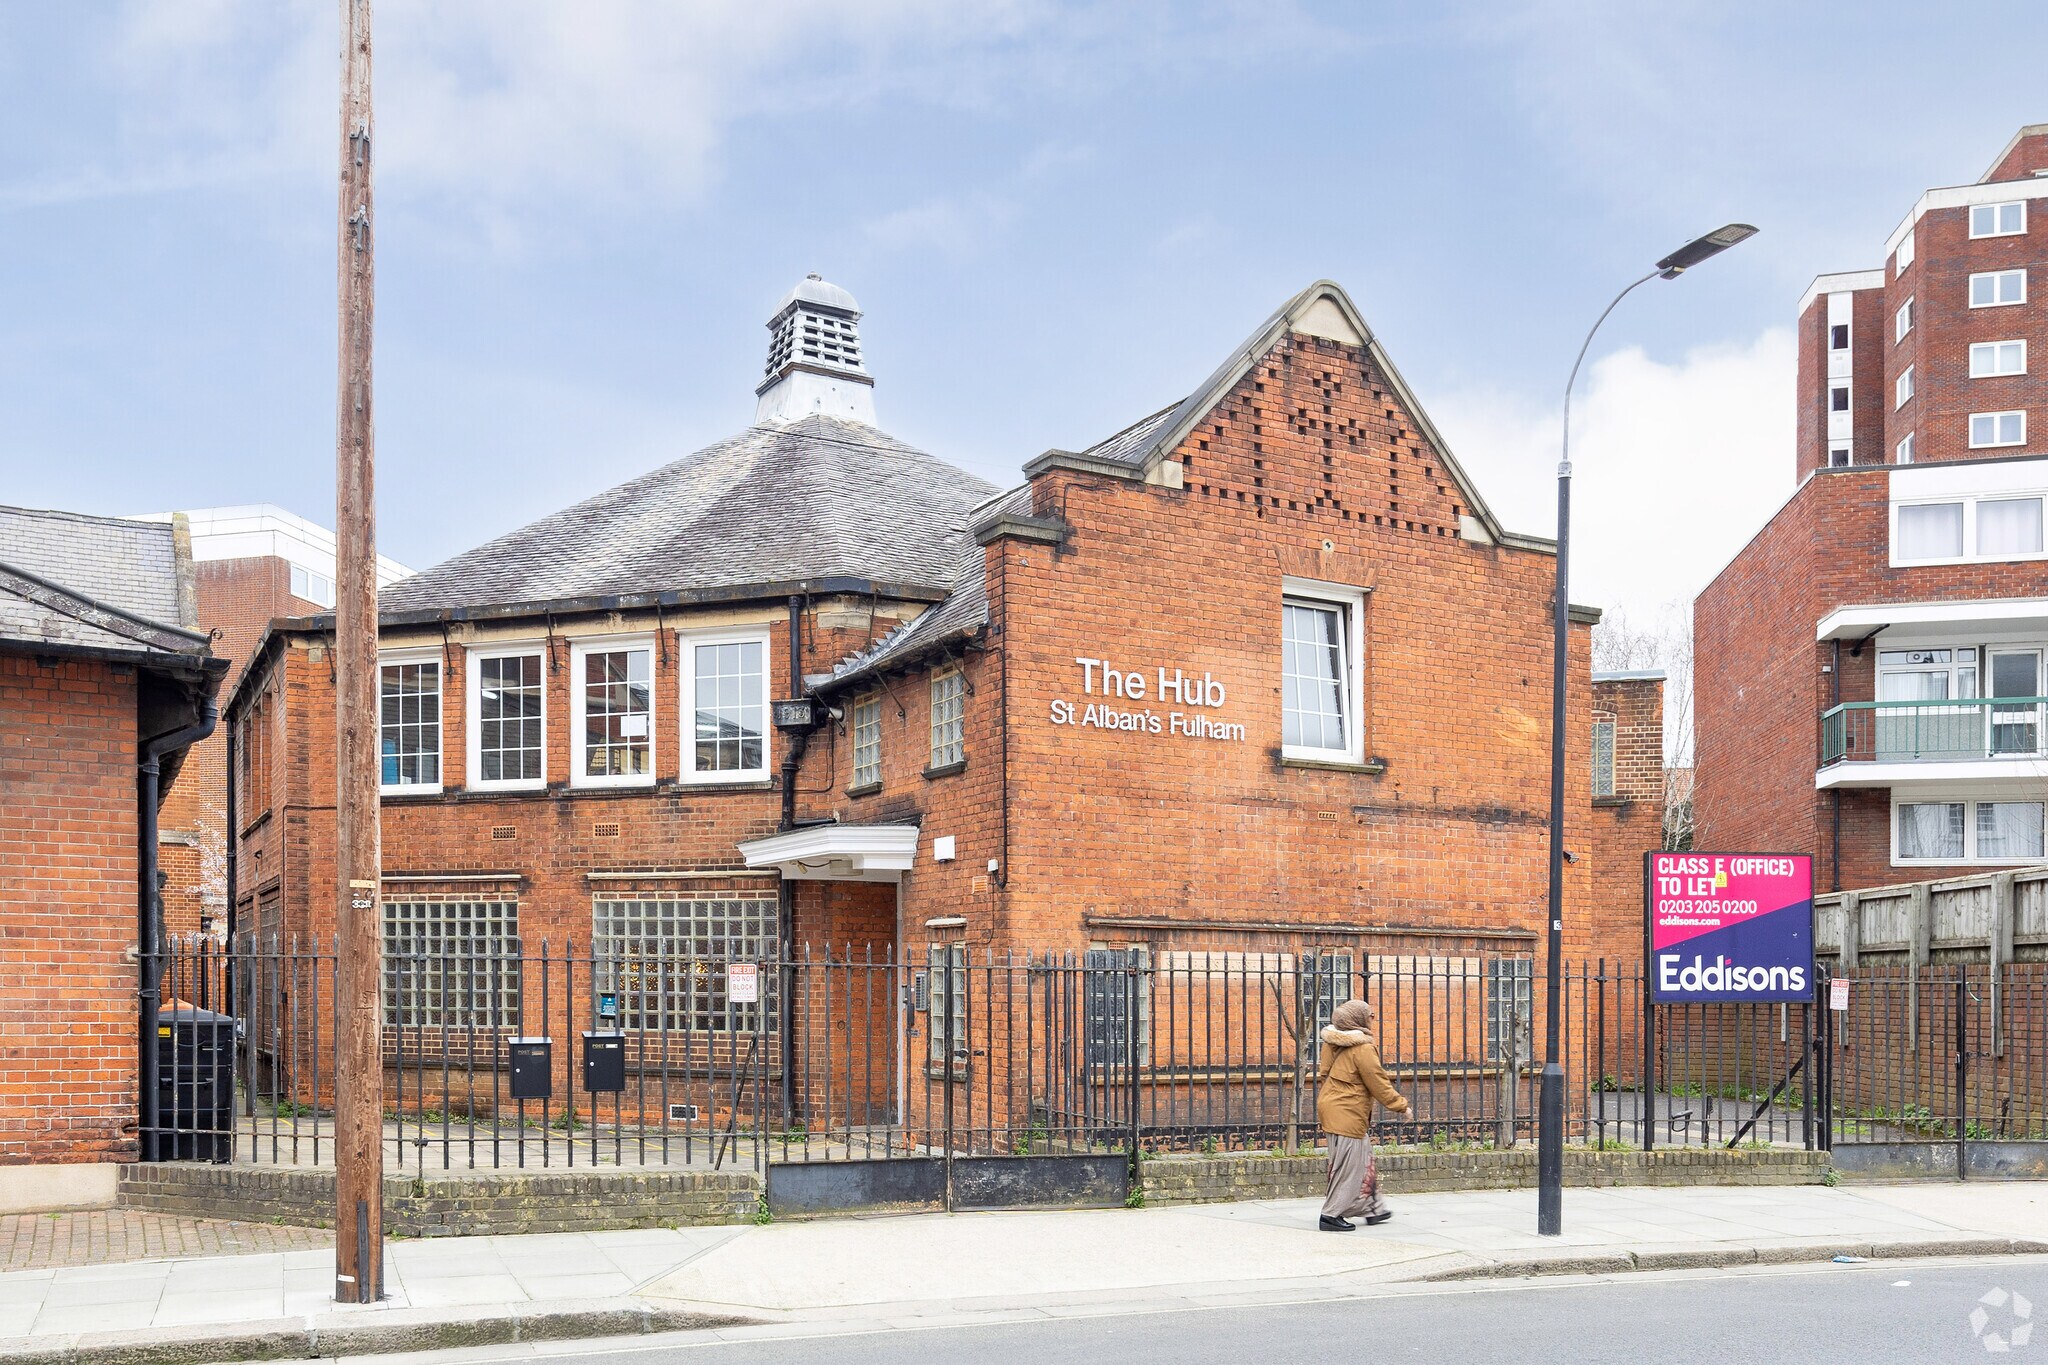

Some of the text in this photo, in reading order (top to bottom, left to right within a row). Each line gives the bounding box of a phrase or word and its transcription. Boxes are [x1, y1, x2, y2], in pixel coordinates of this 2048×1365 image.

[1075, 656, 1226, 708] The Hub
[1050, 699, 1245, 741] St Alban's Fulham
[1658, 857, 1794, 877] CLASS E (OFFICE)
[1657, 876, 1717, 896] TO LET
[1659, 899, 1758, 914] 0203 205 0200
[1659, 915, 1721, 926] eddisons.com
[1659, 954, 1806, 992] Eddisons
